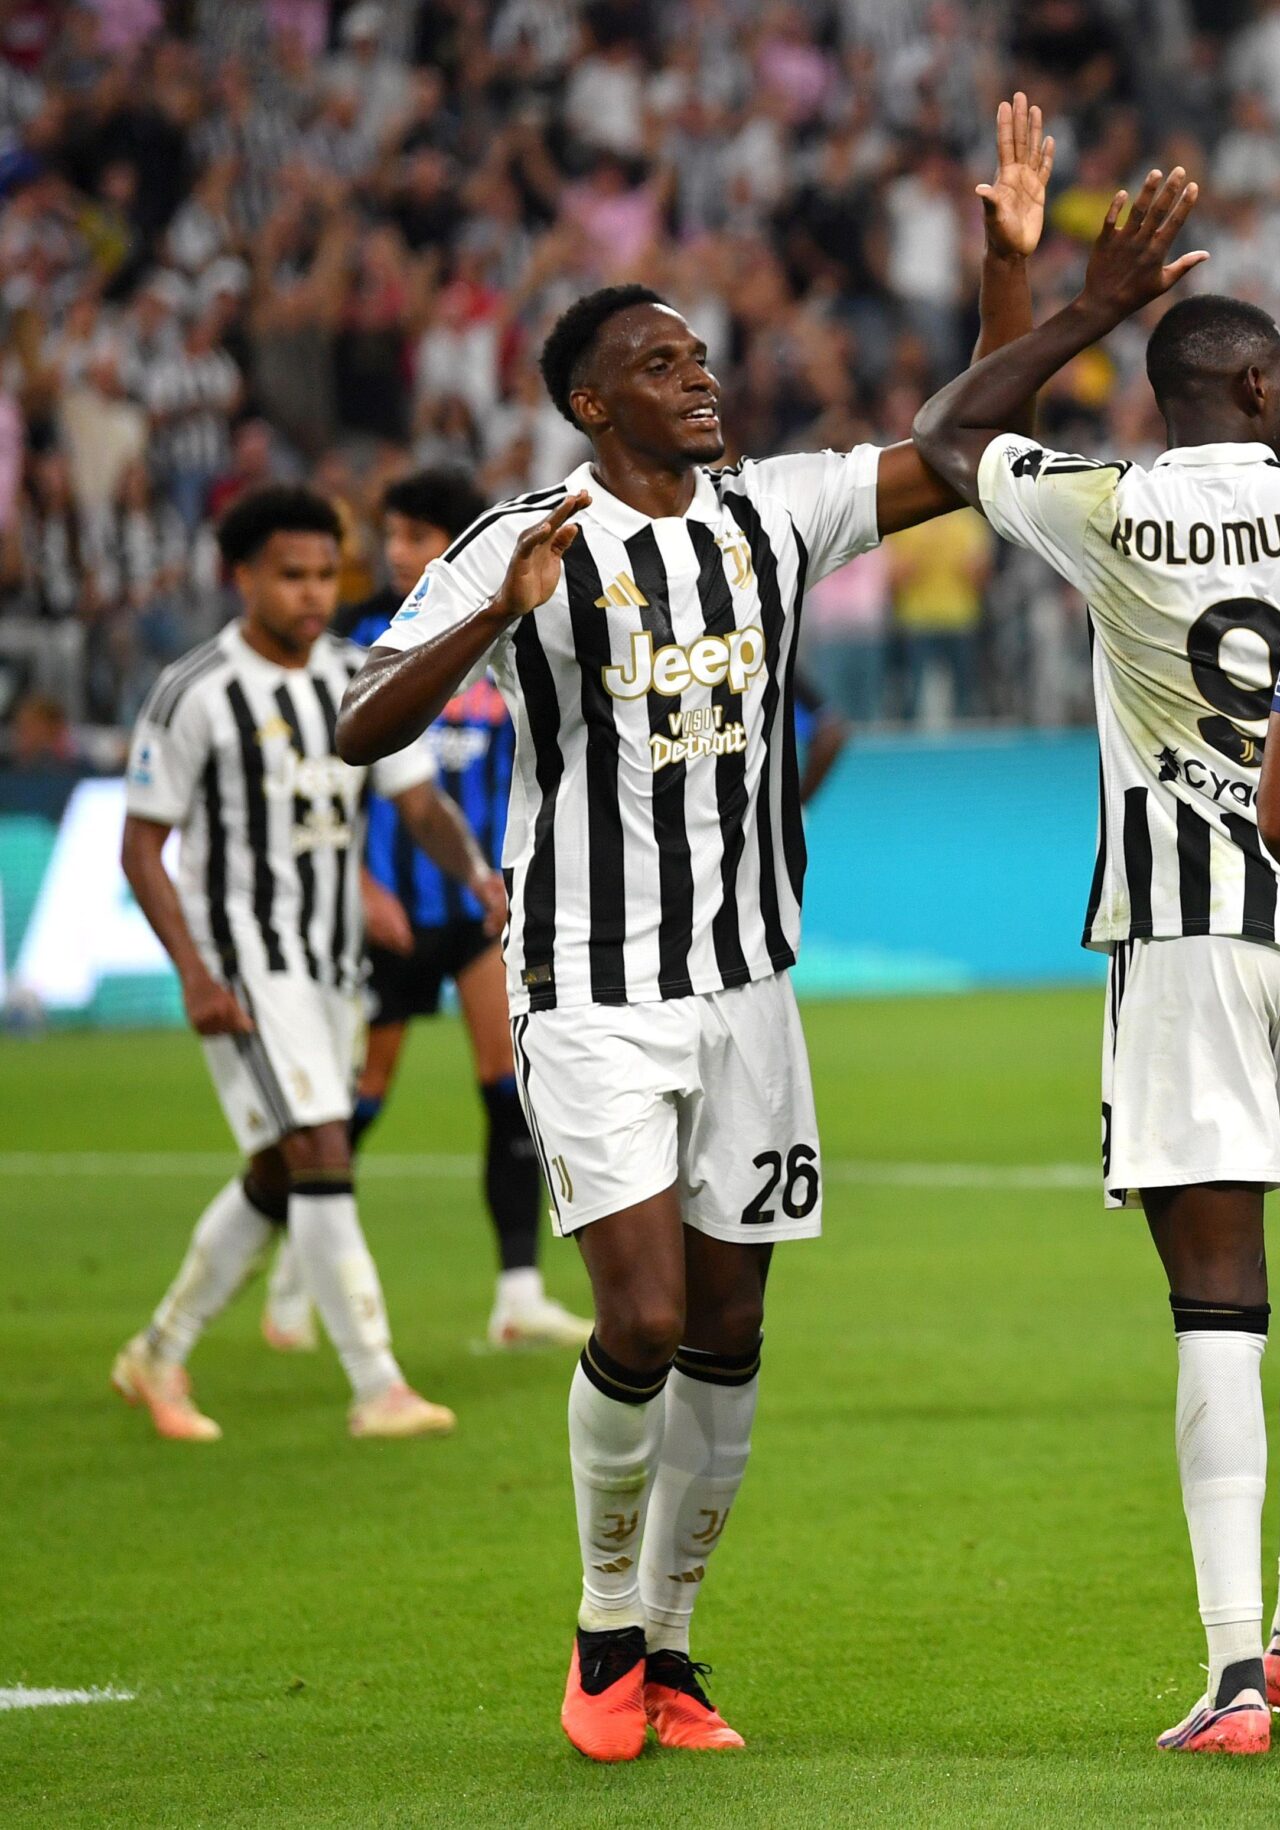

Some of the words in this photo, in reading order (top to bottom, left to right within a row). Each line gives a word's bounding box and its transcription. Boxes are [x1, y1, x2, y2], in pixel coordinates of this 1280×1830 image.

[601, 625, 766, 700] Jeep
[668, 705, 723, 735] VISIT
[740, 1143, 819, 1224] 26
